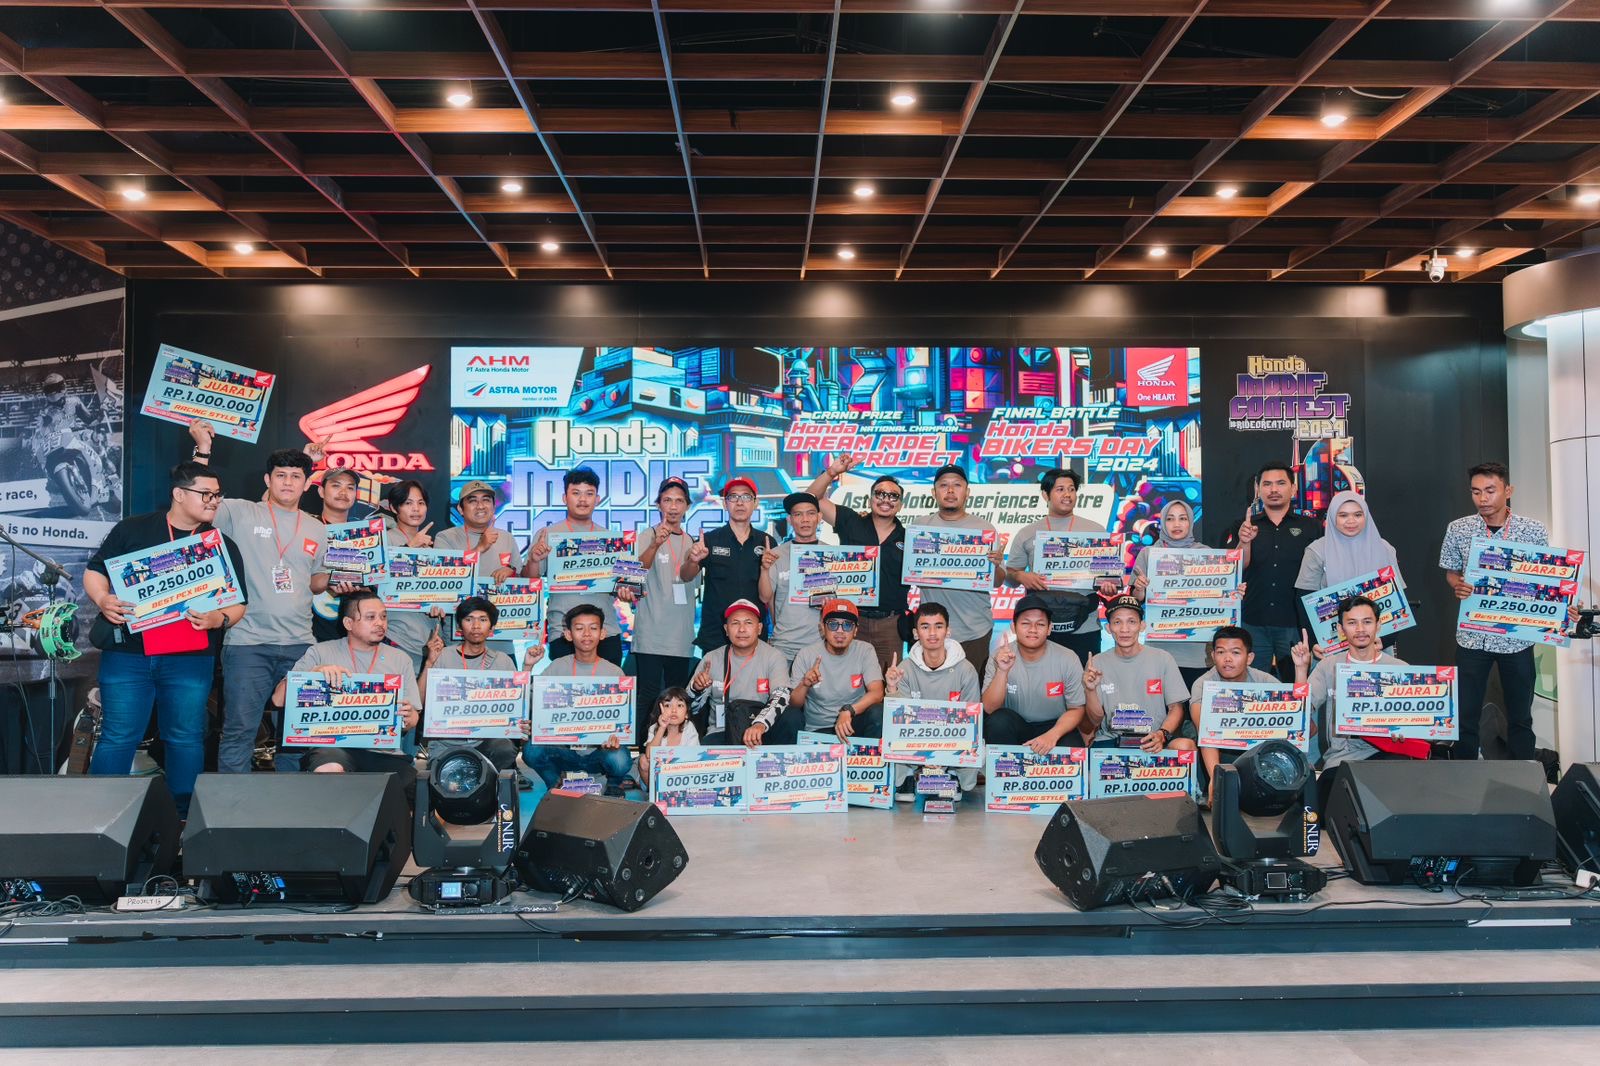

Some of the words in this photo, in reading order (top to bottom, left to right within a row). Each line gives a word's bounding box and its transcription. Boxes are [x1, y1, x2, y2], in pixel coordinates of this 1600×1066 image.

[467, 355, 530, 366] AHM
[1248, 356, 1305, 377] Honda
[204, 381, 245, 397] JUARA
[248, 390, 254, 398] 1
[489, 386, 520, 394] ASTRA
[522, 386, 557, 394] MOTOR
[1237, 373, 1326, 396] MODIF
[163, 387, 254, 413] RP.1.000.000
[1137, 393, 1152, 401] One
[1152, 393, 1177, 401] HEART.
[1231, 395, 1349, 418] CONTEST
[174, 404, 207, 416] RACING
[208, 411, 238, 422] STYLE
[811, 411, 860, 420] GRAND
[861, 411, 903, 420] PRIZE
[992, 407, 1047, 419] FINAL
[1050, 407, 1122, 419] BATTLE
[790, 422, 858, 434] Honda
[987, 421, 1070, 437] Honda
[1298, 419, 1345, 439] 2024
[536, 420, 667, 465] Honda
[786, 435, 875, 450] DREAM
[879, 435, 938, 450] RIDE
[981, 438, 1094, 455] BIKERS
[1101, 438, 1160, 455] DAY
[852, 451, 962, 467] PROJECT
[1096, 457, 1159, 471] 2024
[6, 489, 37, 500] race,
[8, 523, 19, 534] is
[22, 525, 39, 536] no
[42, 526, 88, 540] Honda.
[944, 545, 977, 554] JUARA
[828, 562, 861, 571] JUARA
[862, 562, 868, 570] 2
[915, 558, 986, 567] RP.1.000.000
[421, 568, 457, 576] JUARA
[458, 568, 466, 576] 3
[1187, 565, 1221, 574] JUARA
[1515, 563, 1556, 576] JUARA
[1559, 567, 1568, 576] 3
[137, 563, 214, 600] RP.250.000
[396, 581, 463, 591] RP.700.000
[1163, 577, 1227, 588] RP.700.000
[493, 595, 525, 604] JUARA
[526, 595, 532, 603] 2
[1160, 607, 1225, 618] RP.250.000
[1479, 599, 1558, 615] RP.250.000
[471, 690, 508, 700] JUARA
[509, 689, 517, 698] 2
[1388, 687, 1431, 696] JUARA
[1434, 686, 1440, 695] 1
[337, 695, 378, 705] JUARA
[381, 694, 386, 703] 1
[577, 695, 613, 706] JUARA
[615, 695, 623, 704] 3
[443, 703, 515, 716] RP.800.000
[1248, 703, 1287, 712] JUARA
[1289, 702, 1297, 710] 3
[1351, 700, 1445, 712] RP.1.000.000
[300, 709, 390, 723] RP.1.000.000
[551, 708, 621, 723] RP.700.000
[1220, 716, 1294, 727] RP.700.000
[899, 727, 967, 737] RP.250.000
[789, 763, 826, 774] JUARA
[827, 763, 835, 772] 2
[1029, 767, 1065, 776] JUARA
[1067, 766, 1075, 775] 2
[1136, 769, 1173, 777] JUARA
[1175, 768, 1180, 776] 1
[666, 772, 735, 787] RP.250.000
[764, 777, 833, 792] RP.800.000
[1003, 780, 1073, 791] RP.800.000
[1104, 781, 1184, 794] RP.1.000.000
[502, 821, 515, 852] NUR
[1307, 823, 1319, 854] NUR
